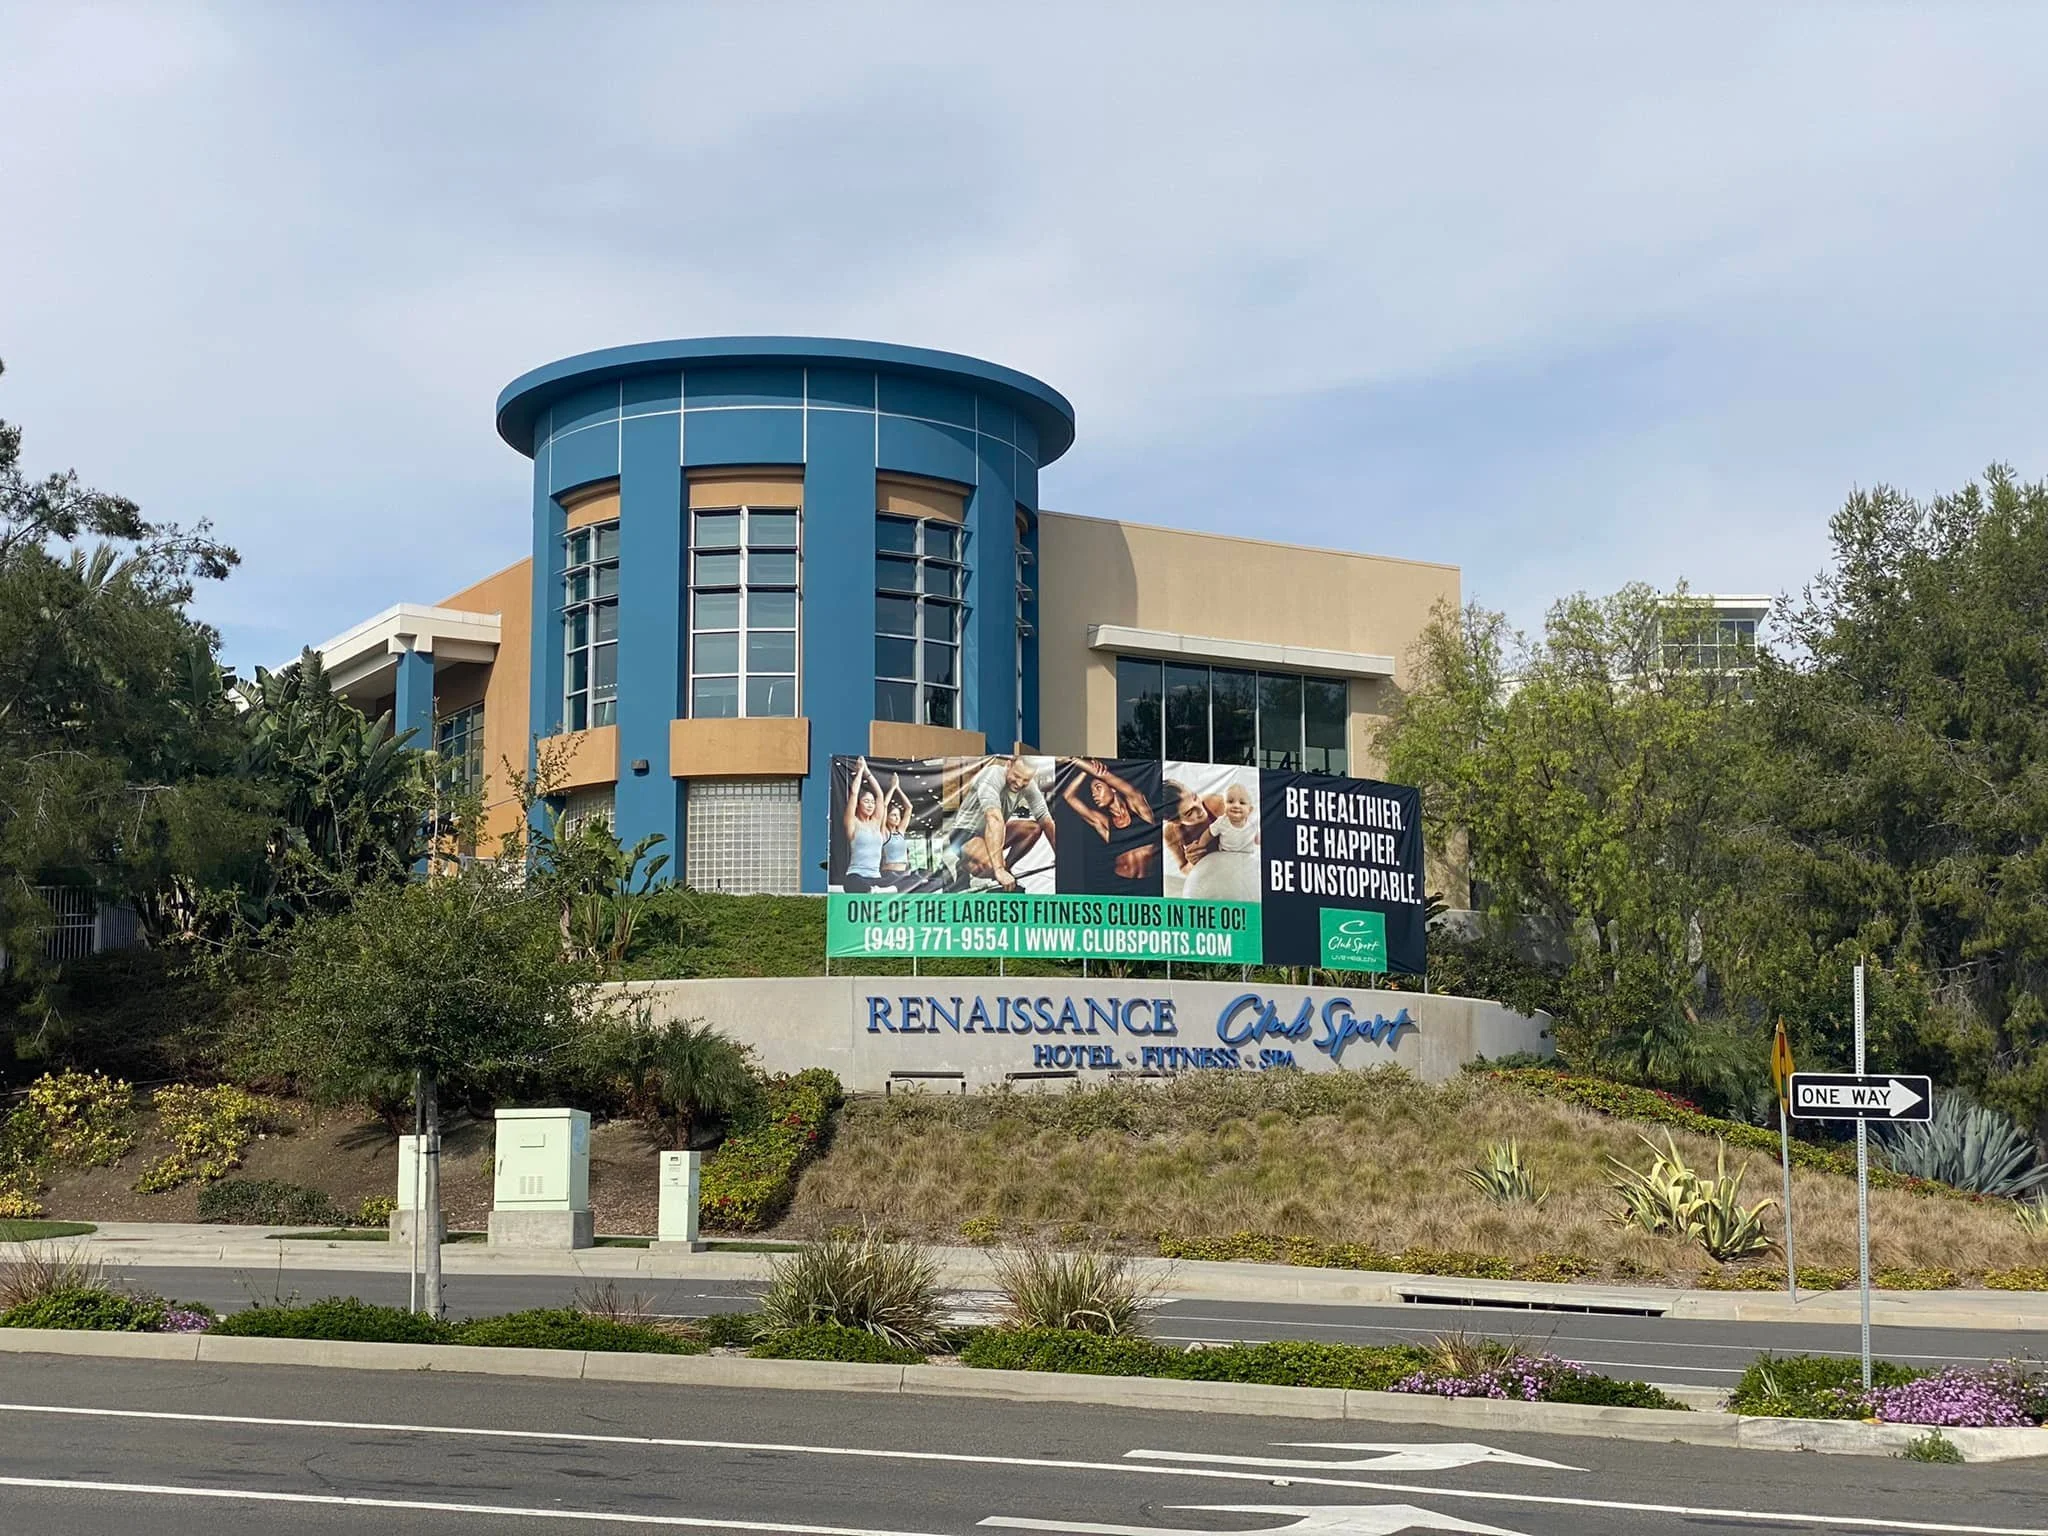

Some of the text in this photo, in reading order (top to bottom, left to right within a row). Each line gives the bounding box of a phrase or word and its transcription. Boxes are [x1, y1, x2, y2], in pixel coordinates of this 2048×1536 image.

[1286, 787, 1406, 831] BE HEALTHIER.
[1296, 824, 1400, 866] BE HAPPIER.
[1271, 860, 1421, 904] BE UNSTOPPABLE.
[848, 900, 1246, 930] ONE OF THE LARGEST FITNESS CLUBS IN THE OC!
[864, 926, 915, 951] (949)
[920, 927, 1009, 951] 771-9554
[866, 996, 1179, 1036] RENAISSANCE
[1033, 1044, 1297, 1071] HOTEL FITNESS SPA
[1802, 1088, 1891, 1106] ONE WAY
